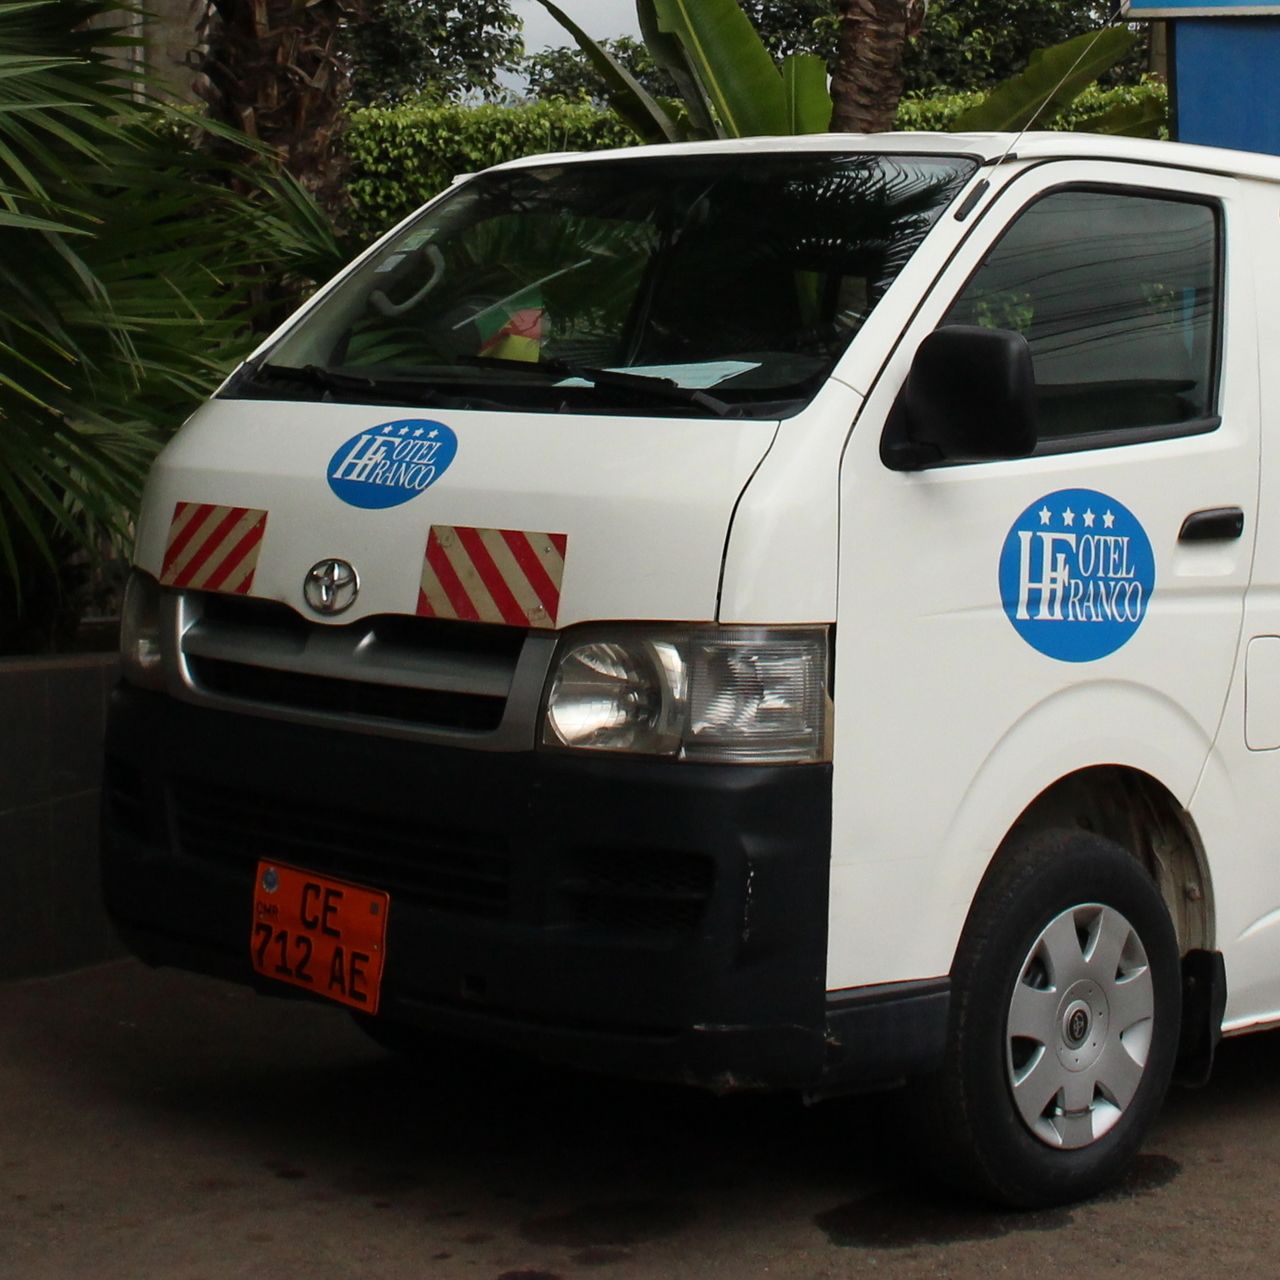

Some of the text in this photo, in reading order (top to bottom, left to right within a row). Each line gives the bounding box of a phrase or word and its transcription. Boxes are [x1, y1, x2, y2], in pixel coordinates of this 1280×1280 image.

[300, 882, 344, 939] CE
[254, 922, 370, 1003] 712 AE
